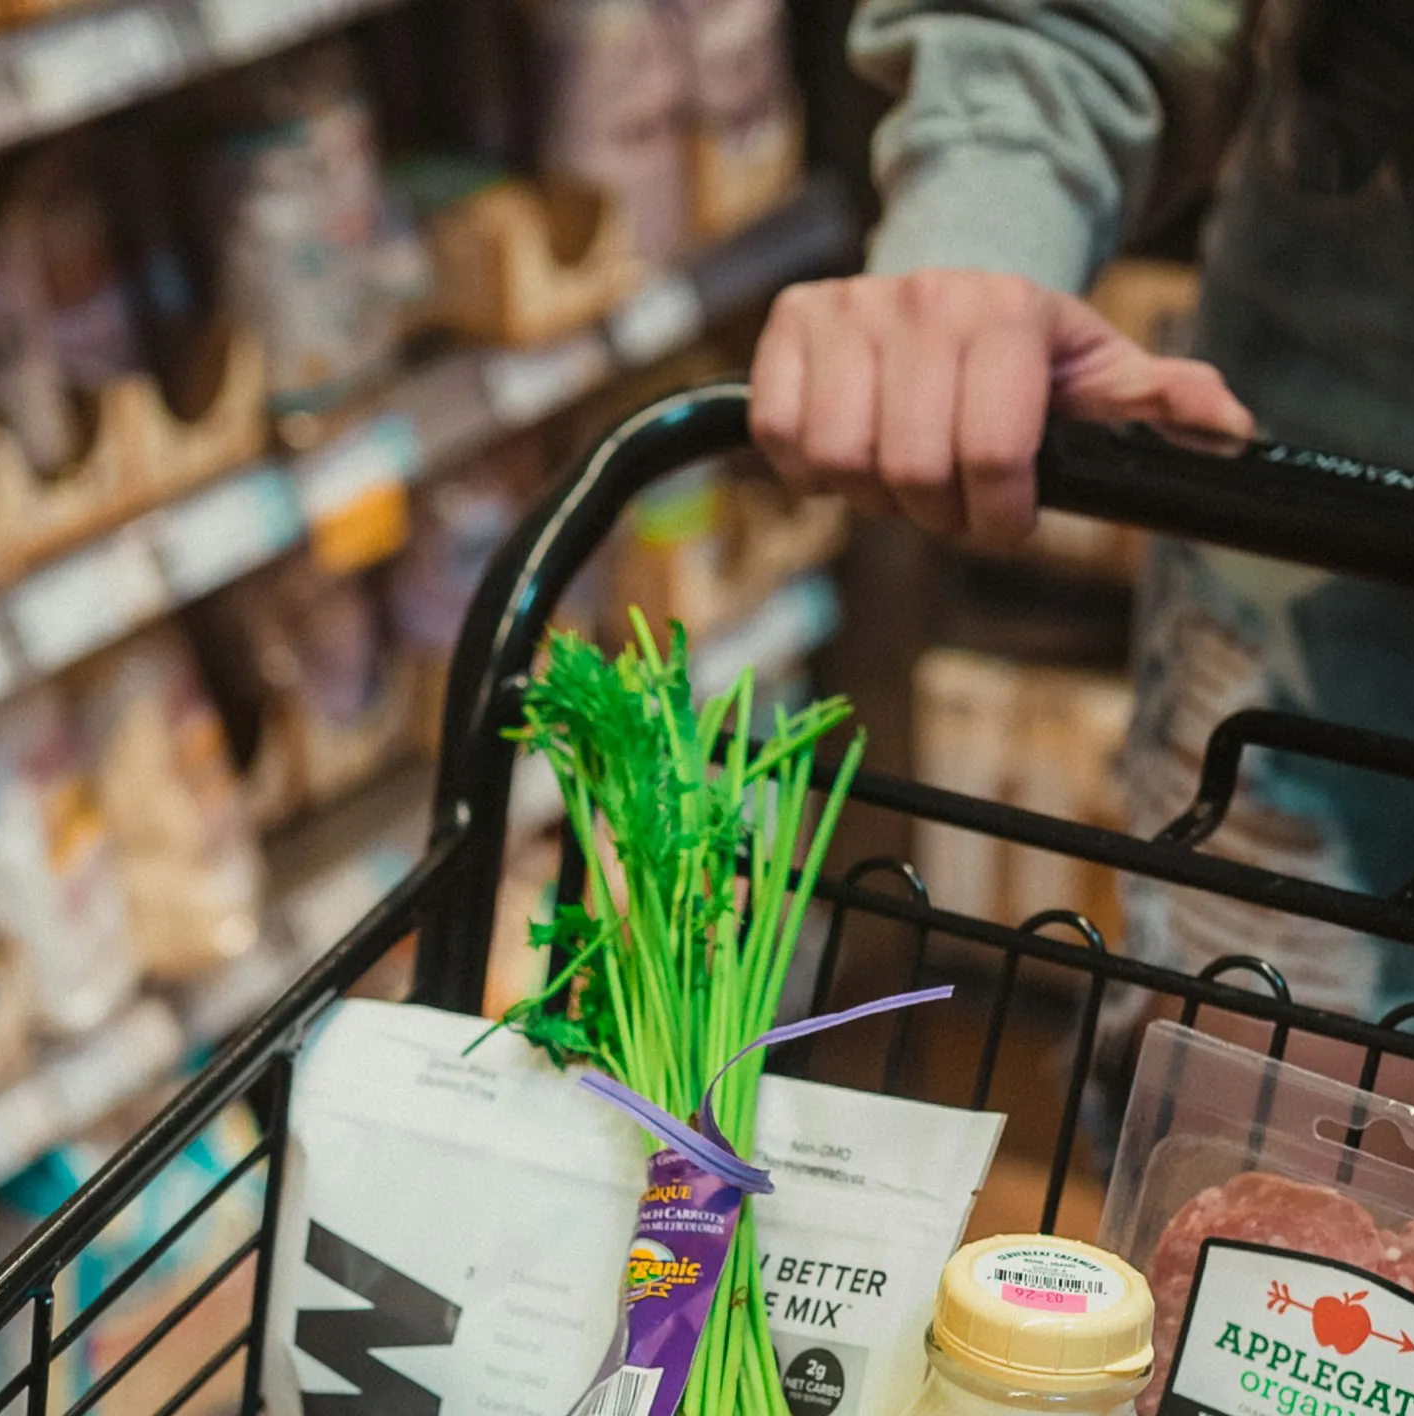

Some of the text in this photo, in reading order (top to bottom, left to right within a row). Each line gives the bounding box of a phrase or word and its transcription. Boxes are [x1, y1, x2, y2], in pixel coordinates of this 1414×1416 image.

[777, 1257, 887, 1297] BETTER
[805, 1358, 827, 1382] 2g
[805, 1379, 842, 1399] CARBS
